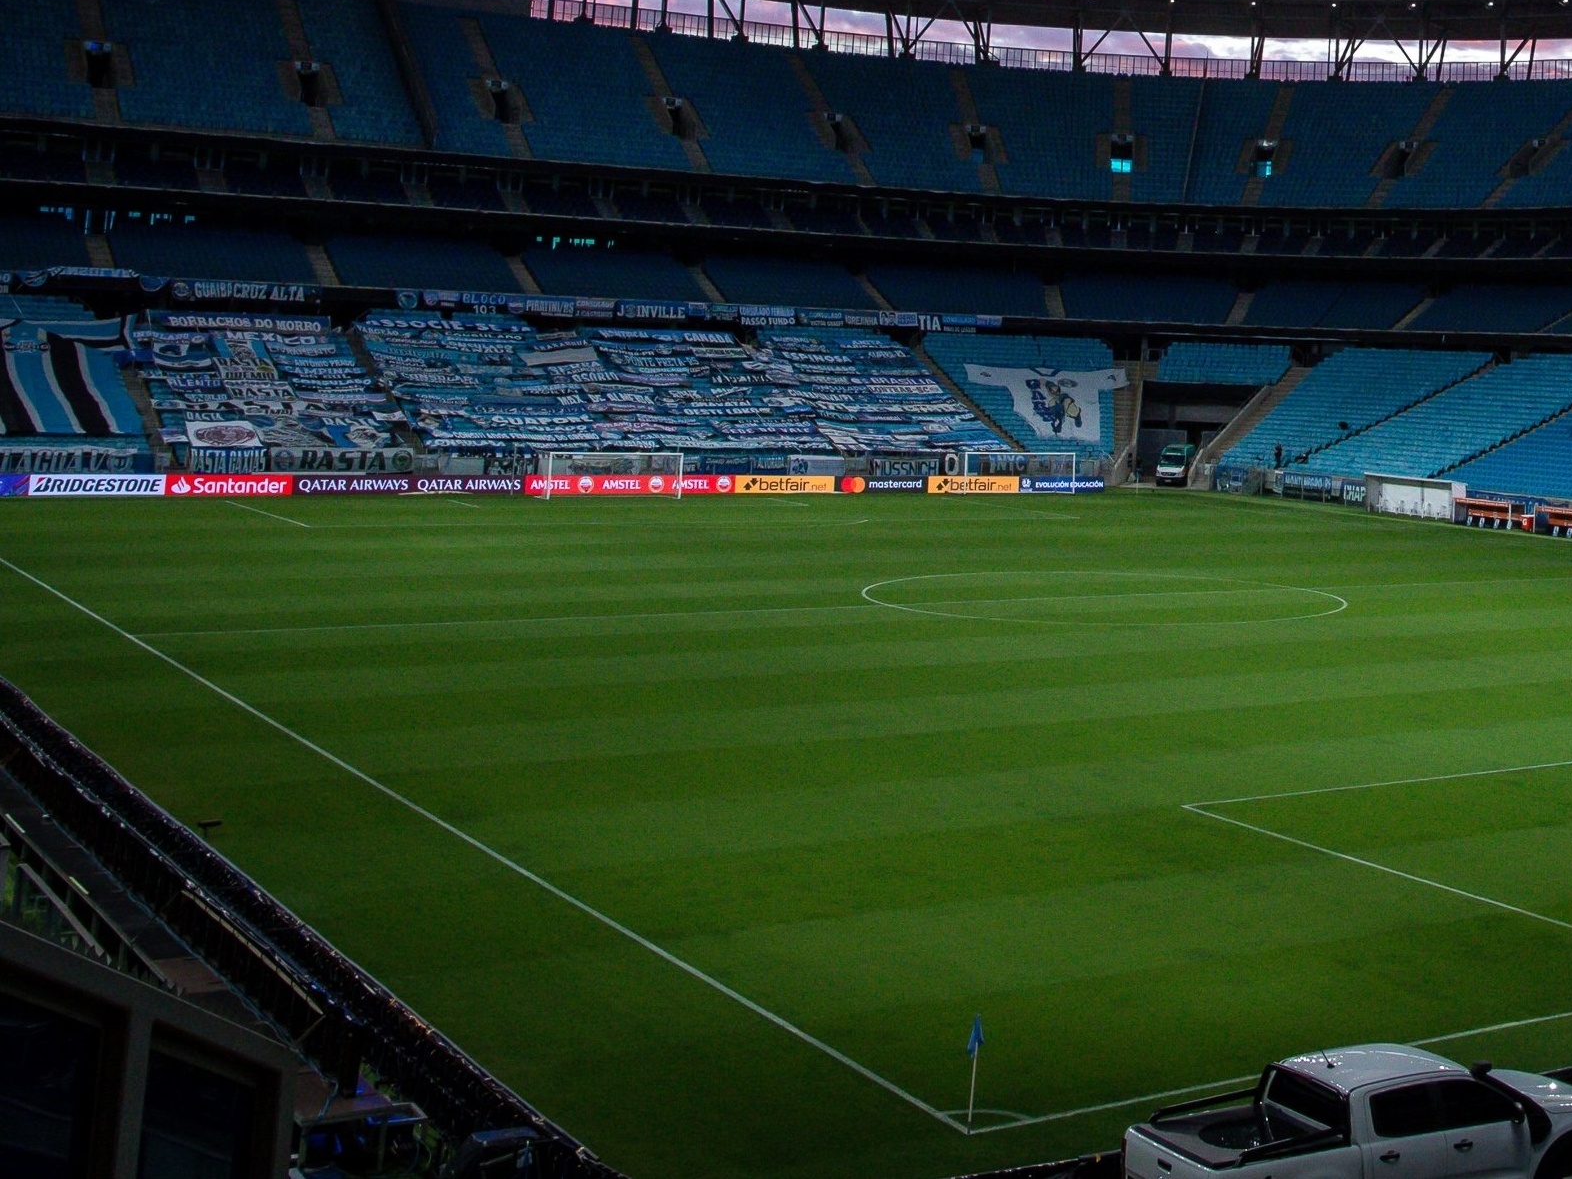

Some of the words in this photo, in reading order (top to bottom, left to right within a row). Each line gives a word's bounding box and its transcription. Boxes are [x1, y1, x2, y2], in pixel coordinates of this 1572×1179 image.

[233, 283, 268, 300] CRUZ
[269, 286, 305, 302] ALTA
[462, 293, 506, 305] BLOCO
[472, 304, 497, 314] 103
[168, 315, 252, 328] BORRACHOS
[254, 318, 273, 328] DO
[276, 320, 322, 333] MORRO
[741, 316, 767, 326] PASSO
[768, 316, 796, 325] FUNDO
[918, 315, 942, 331] TIA
[226, 330, 317, 346] MEXICO
[684, 332, 735, 345] CANADA
[299, 449, 387, 471] RASTA
[34, 477, 162, 492] BRIDGESTONE
[193, 477, 287, 494] Santander
[298, 479, 347, 492] QATAR
[350, 479, 409, 491] AIRWAYS
[417, 479, 462, 492] QATAR
[464, 479, 521, 491] AIRWAYS
[530, 480, 570, 490] AMSTEL
[602, 480, 641, 490] AMSTEL
[672, 480, 709, 490] AMSTEL
[759, 478, 827, 492] betfair.net
[868, 479, 923, 489] mastercard
[949, 478, 1012, 492] betfair.net
